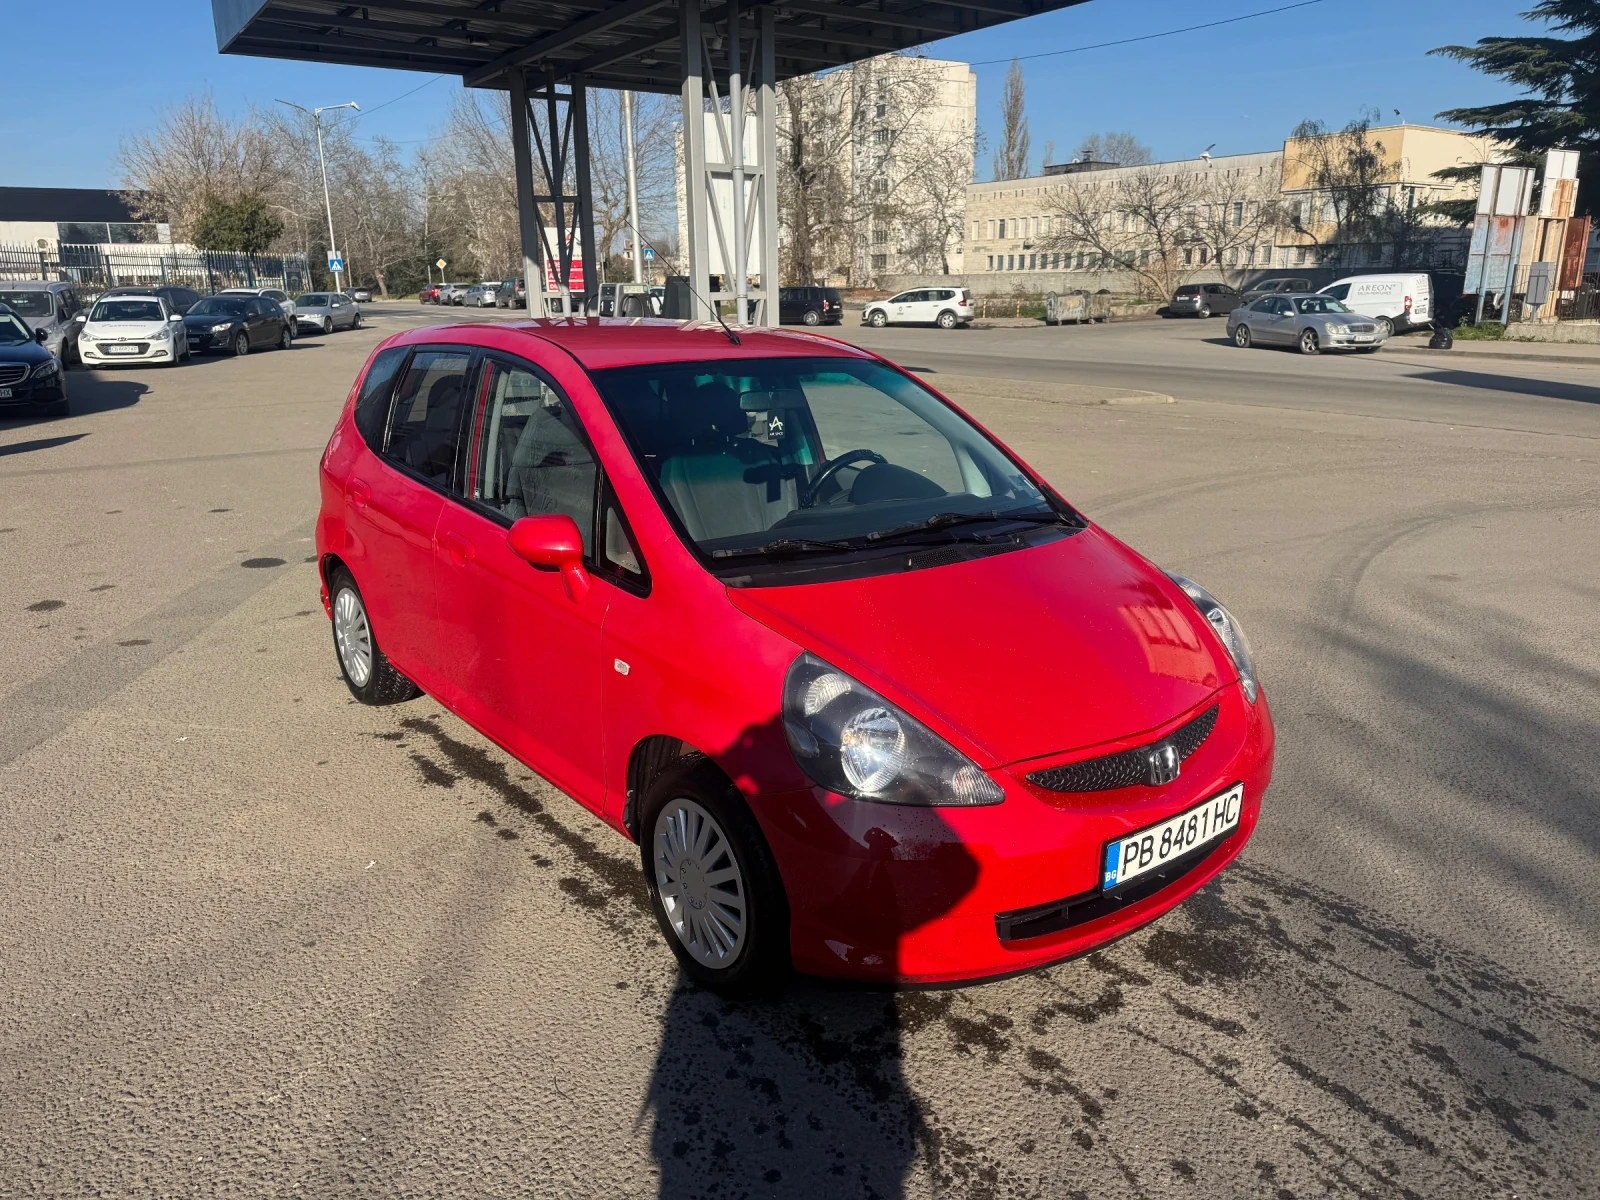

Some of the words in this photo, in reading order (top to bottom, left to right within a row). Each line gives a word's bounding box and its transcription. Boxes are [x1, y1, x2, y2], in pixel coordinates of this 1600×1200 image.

[601, 301, 604, 311] 1
[610, 301, 614, 311] 3
[1122, 835, 1154, 876] PB
[1158, 808, 1209, 860] 8481
[1212, 793, 1238, 833] HC
[1104, 870, 1117, 882] BG
